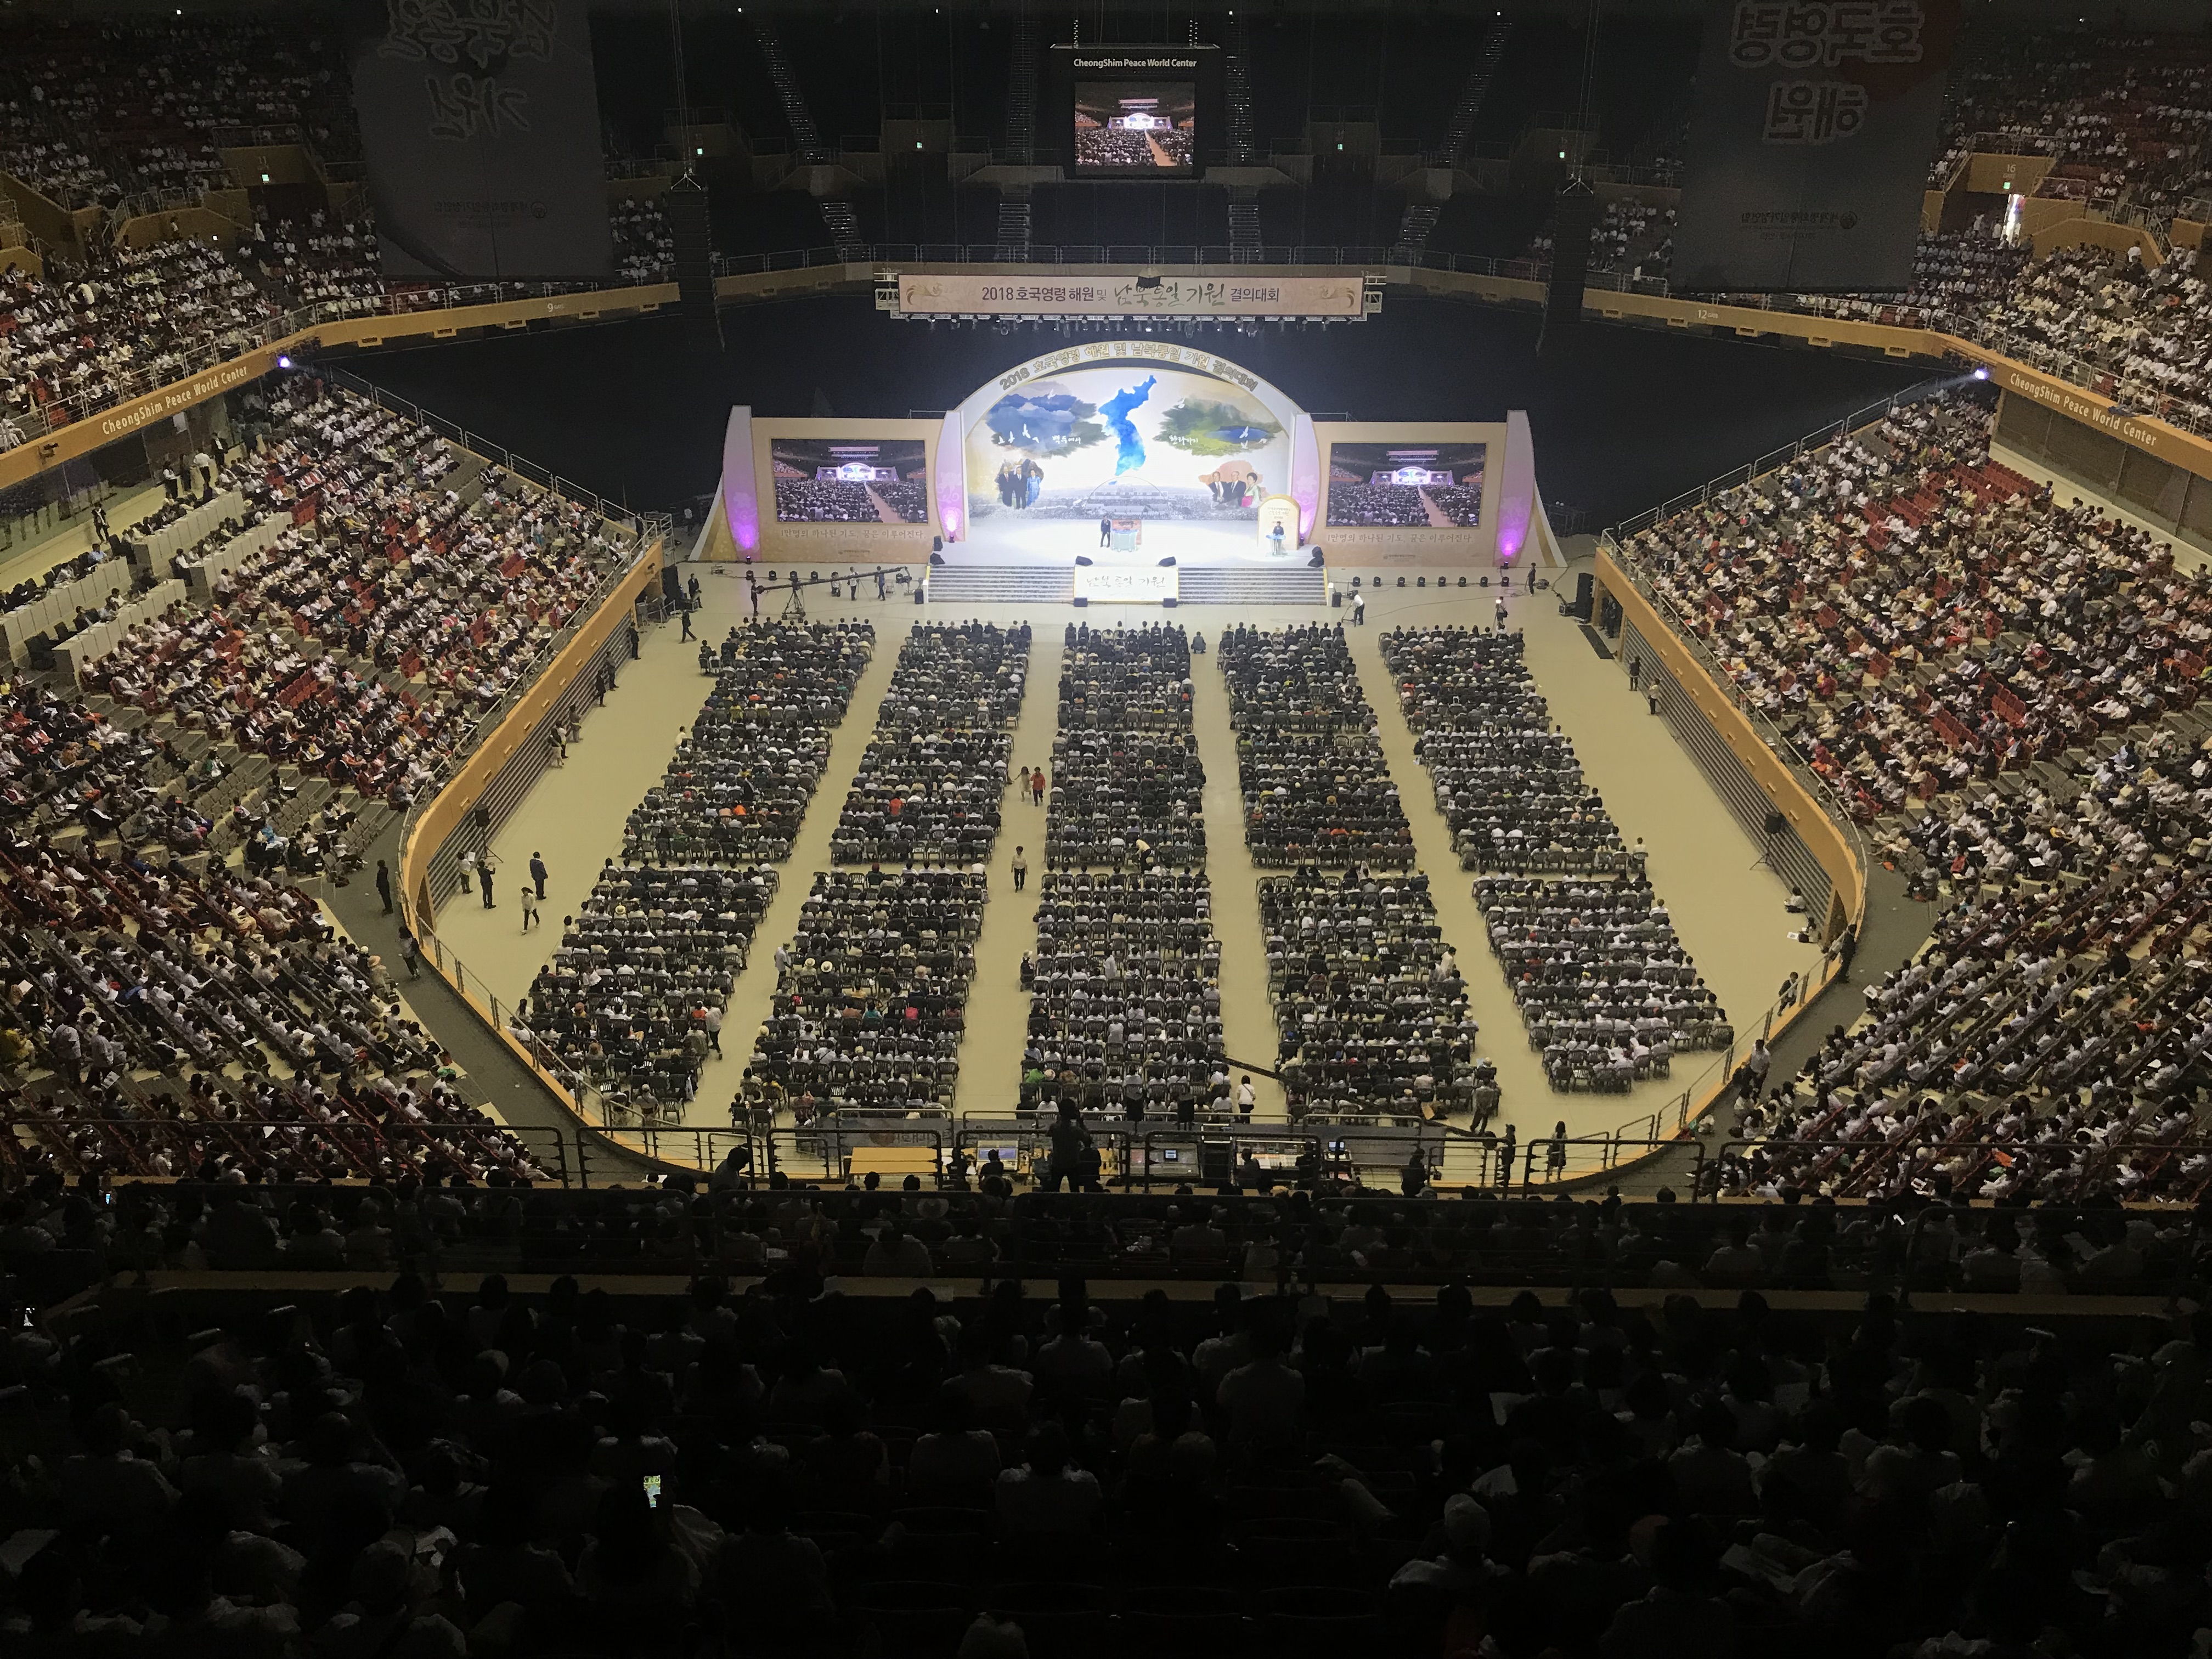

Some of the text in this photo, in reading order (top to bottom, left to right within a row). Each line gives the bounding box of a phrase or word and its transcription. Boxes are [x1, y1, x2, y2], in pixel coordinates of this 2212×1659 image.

[1074, 58, 1197, 69] CheongShim Peace World Center
[2007, 164, 2016, 173] 16
[981, 287, 1013, 300] 2018
[1015, 286, 1066, 301] 호국영령
[1068, 286, 1093, 301] 해원
[1097, 289, 1106, 301] 및
[1186, 283, 1225, 306] 기원
[1231, 287, 1279, 302] 결의대회
[547, 303, 553, 313] 9
[1698, 309, 1707, 319] 12
[1000, 342, 1259, 392] 2018 호국영령 해원 및 남북통일 기원 결의대회
[102, 366, 247, 435] CheongShim Peace World Center
[2010, 373, 2157, 446] CheongShim Peace World Center
[1052, 435, 1081, 444] 백두에서
[812, 529, 836, 538] 하나된
[862, 529, 879, 538] 꿈은
[882, 529, 926, 539] 이루어진다.
[1359, 533, 1384, 543] 하나된
[1410, 534, 1426, 543] 꿈은
[1138, 577, 1165, 588] 기원
